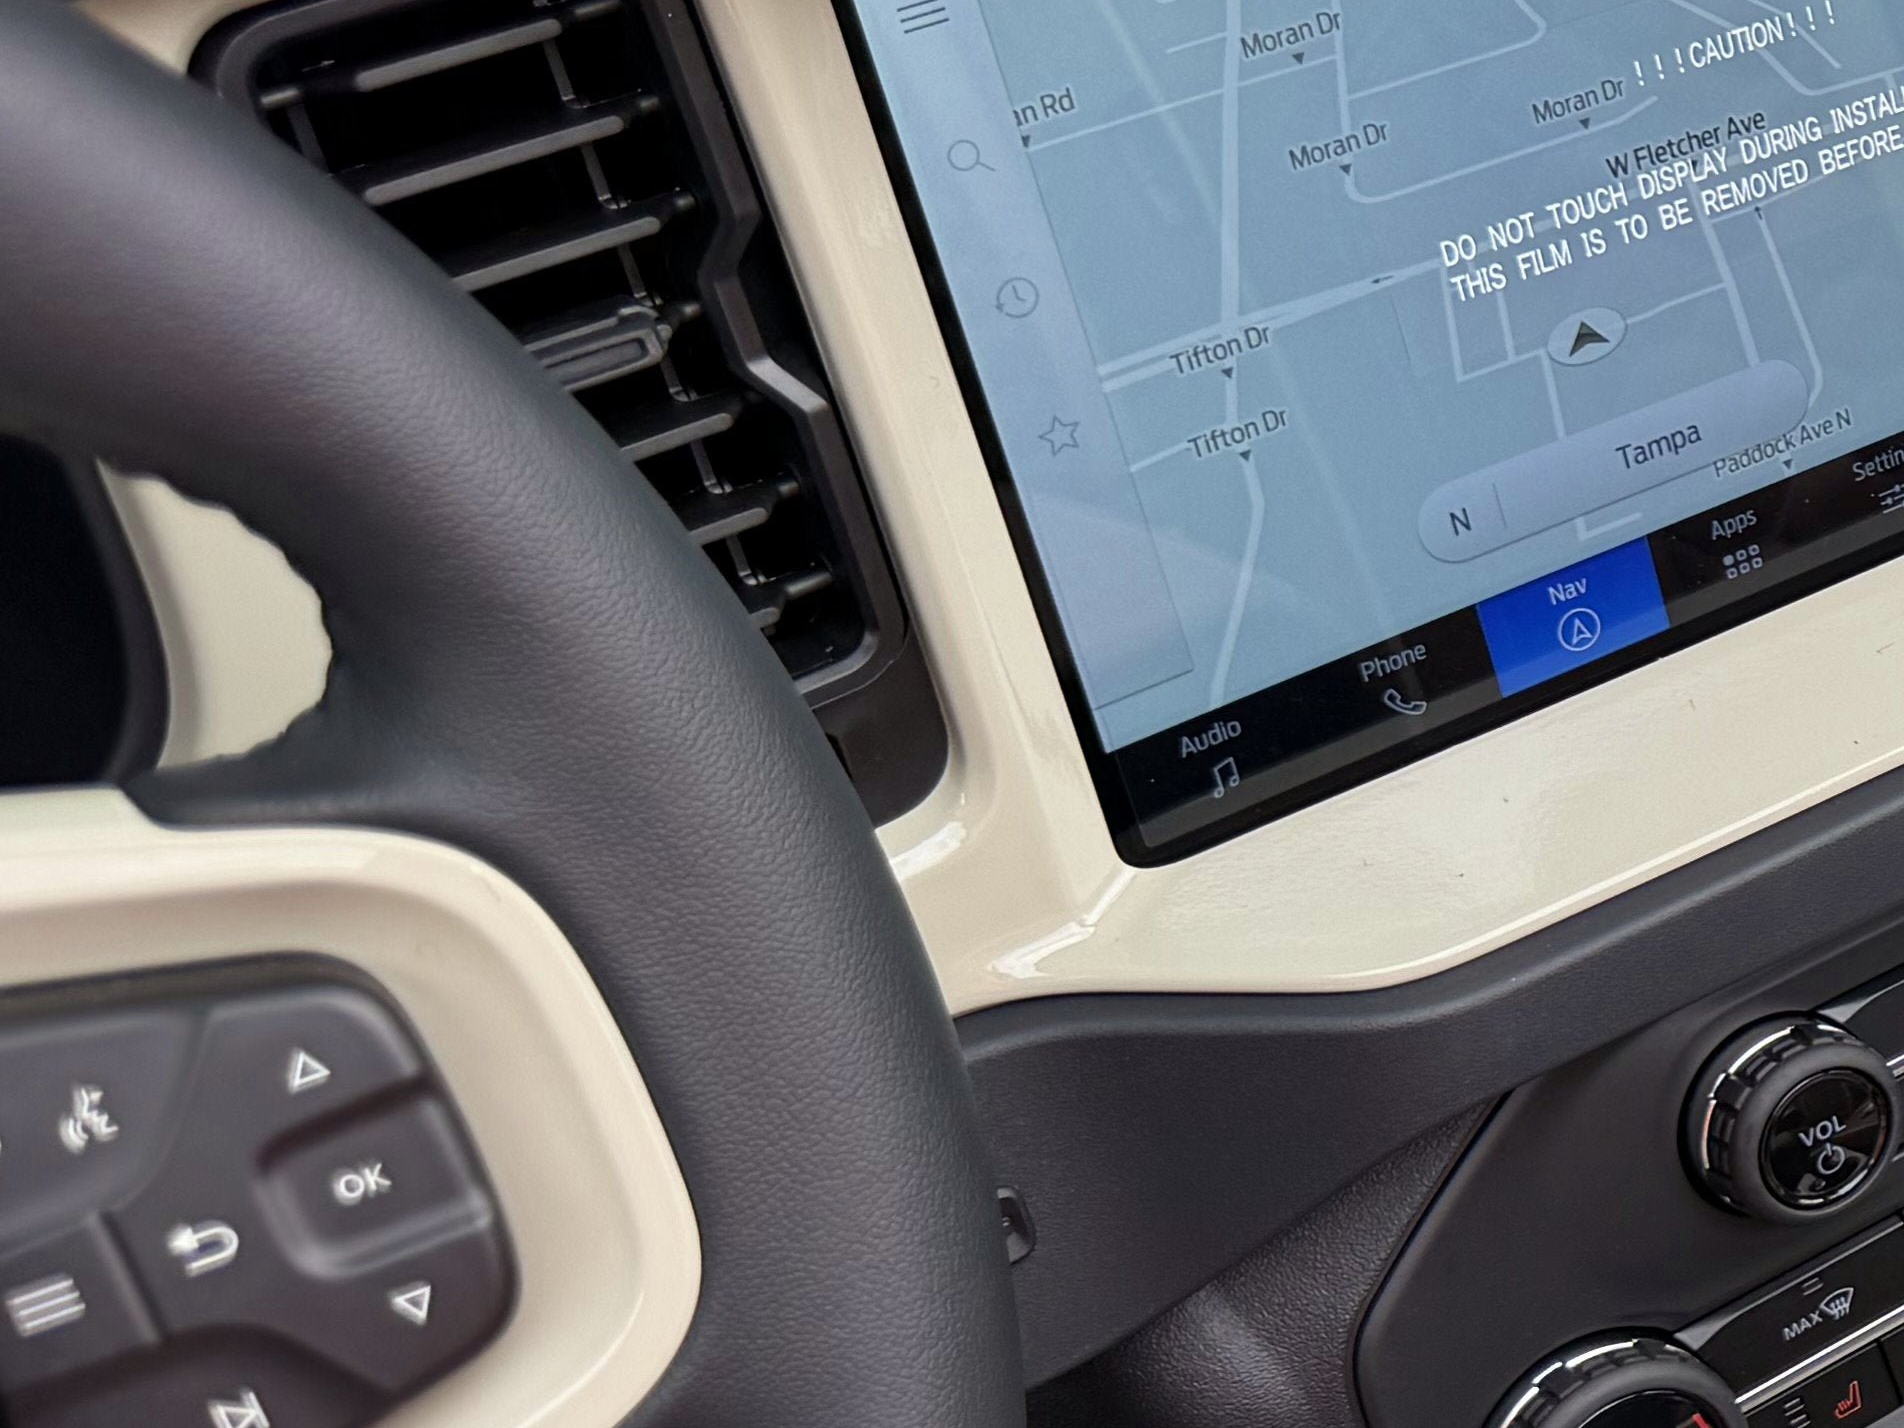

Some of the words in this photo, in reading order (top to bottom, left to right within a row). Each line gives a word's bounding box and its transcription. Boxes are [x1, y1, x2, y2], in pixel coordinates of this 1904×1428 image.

[1240, 21, 1314, 59] Moran
[1316, 11, 1342, 35] Dr
[1040, 86, 1075, 118] Rd
[1531, 92, 1599, 126] Moran
[1600, 77, 1625, 101] Dr
[1289, 135, 1361, 172] Moran
[1362, 121, 1389, 148] Dr
[1606, 152, 1631, 179] W
[1632, 124, 1722, 171] Fletcher
[1725, 110, 1767, 140] Ave
[1440, 235, 1477, 268] DO
[1487, 212, 1536, 254] NOT
[1546, 186, 1629, 230] TOUCH
[1636, 153, 1728, 201] DISPLAY
[1741, 118, 1823, 164] DURING
[1450, 264, 1507, 302] THIS
[1518, 240, 1573, 281] FILM
[1583, 229, 1607, 258] IS
[1615, 216, 1649, 246] TO
[1658, 199, 1694, 231] BE
[1701, 158, 1810, 220] REMOVED
[1818, 125, 1904, 176] BEFORE
[1170, 335, 1242, 376] Tifton
[1244, 325, 1272, 349] Dr
[1187, 420, 1260, 460] Tifton
[1262, 408, 1288, 432] Dr
[1616, 423, 1703, 471] Tampa
[1713, 435, 1796, 479] Paddock
[1799, 418, 1834, 445] Ave
[1834, 408, 1853, 430] N
[1449, 507, 1472, 536] N
[1711, 509, 1757, 541] Apps
[1547, 577, 1588, 606] Nav
[1359, 642, 1427, 683] Phone
[1179, 719, 1242, 759] Audio
[1798, 1115, 1846, 1149] VOL
[332, 1162, 392, 1206] OK
[1783, 1309, 1824, 1341] MAX
